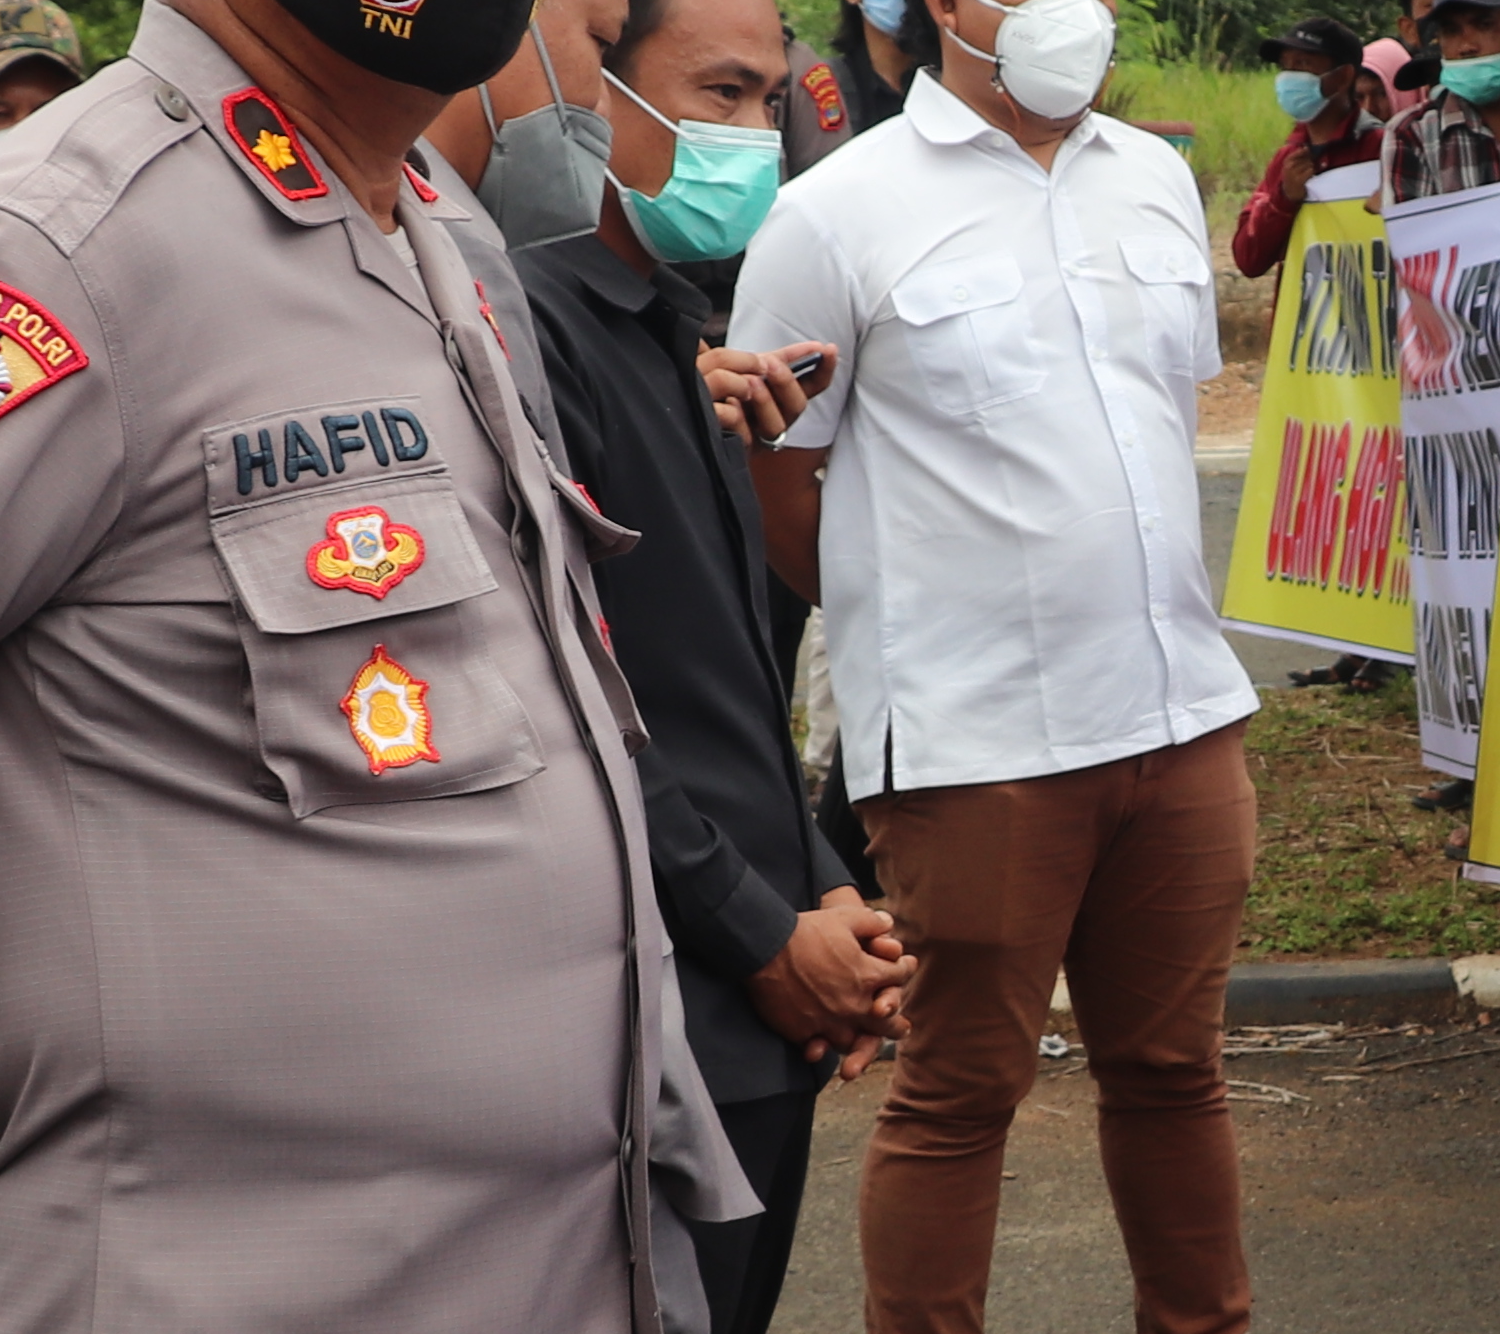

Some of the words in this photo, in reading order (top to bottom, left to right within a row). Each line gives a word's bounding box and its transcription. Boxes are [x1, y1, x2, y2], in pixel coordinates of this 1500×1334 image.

[360, 7, 413, 39] TNI
[3, 303, 74, 366] POLRI
[232, 407, 429, 496] HAFID
